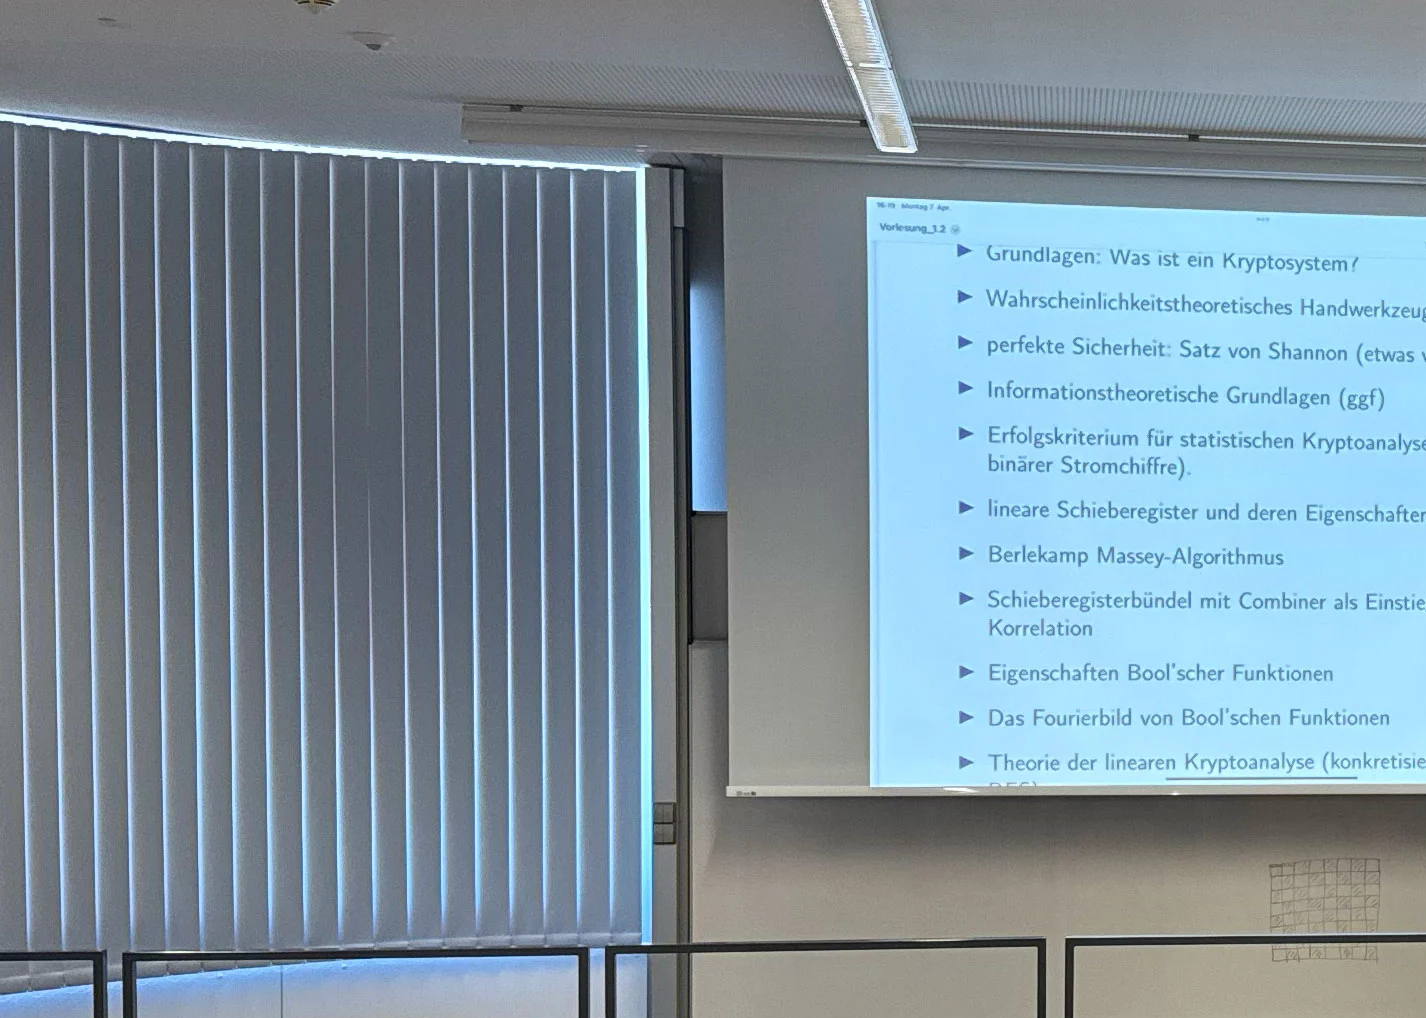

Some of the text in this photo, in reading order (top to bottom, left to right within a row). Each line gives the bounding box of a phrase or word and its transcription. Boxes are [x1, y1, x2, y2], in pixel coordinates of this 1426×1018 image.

[879, 222, 947, 235] Vorlesung_1.2
[985, 244, 1359, 275] Grundlagen: Was ist ein Kryptosystem?
[985, 288, 1293, 316] Wahrscheinlichkeitstheoretisches
[987, 333, 1065, 357] perfekte
[1071, 336, 1172, 357] Sicherheit:
[1179, 339, 1221, 359] Satz
[1227, 345, 1261, 360] von
[1267, 341, 1349, 361] Shannon
[1355, 342, 1415, 367] (etwas
[987, 379, 1385, 413] Informationstheoretische Grundlagen (ggf)
[987, 425, 1139, 449] Erfolgskriterium
[1145, 427, 1175, 447] für
[1179, 429, 1295, 449] statistischen
[987, 453, 1192, 481] binärer Stromchiffre).
[987, 497, 1051, 519] lineare
[1057, 499, 1199, 525] Schieberegister
[1205, 501, 1240, 521] und
[1247, 501, 1297, 522] deren
[989, 543, 1285, 570] Berlekamp Massey-Algorithmus
[987, 589, 1193, 613] Schieberegisterbündel
[1199, 591, 1231, 610] mit
[1238, 591, 1327, 611] Combiner
[1333, 591, 1359, 611] als
[988, 617, 1093, 637] Korrelation
[989, 661, 1334, 687] Eigenschaften Bool'scher Funktionen
[989, 707, 1391, 727] Das Fourierbild von Bool'schen Funktionen
[987, 752, 1061, 772] Theorie
[1067, 752, 1098, 771] der
[1105, 752, 1177, 771] linearen
[1184, 751, 1315, 775] Kryptoanalyse
